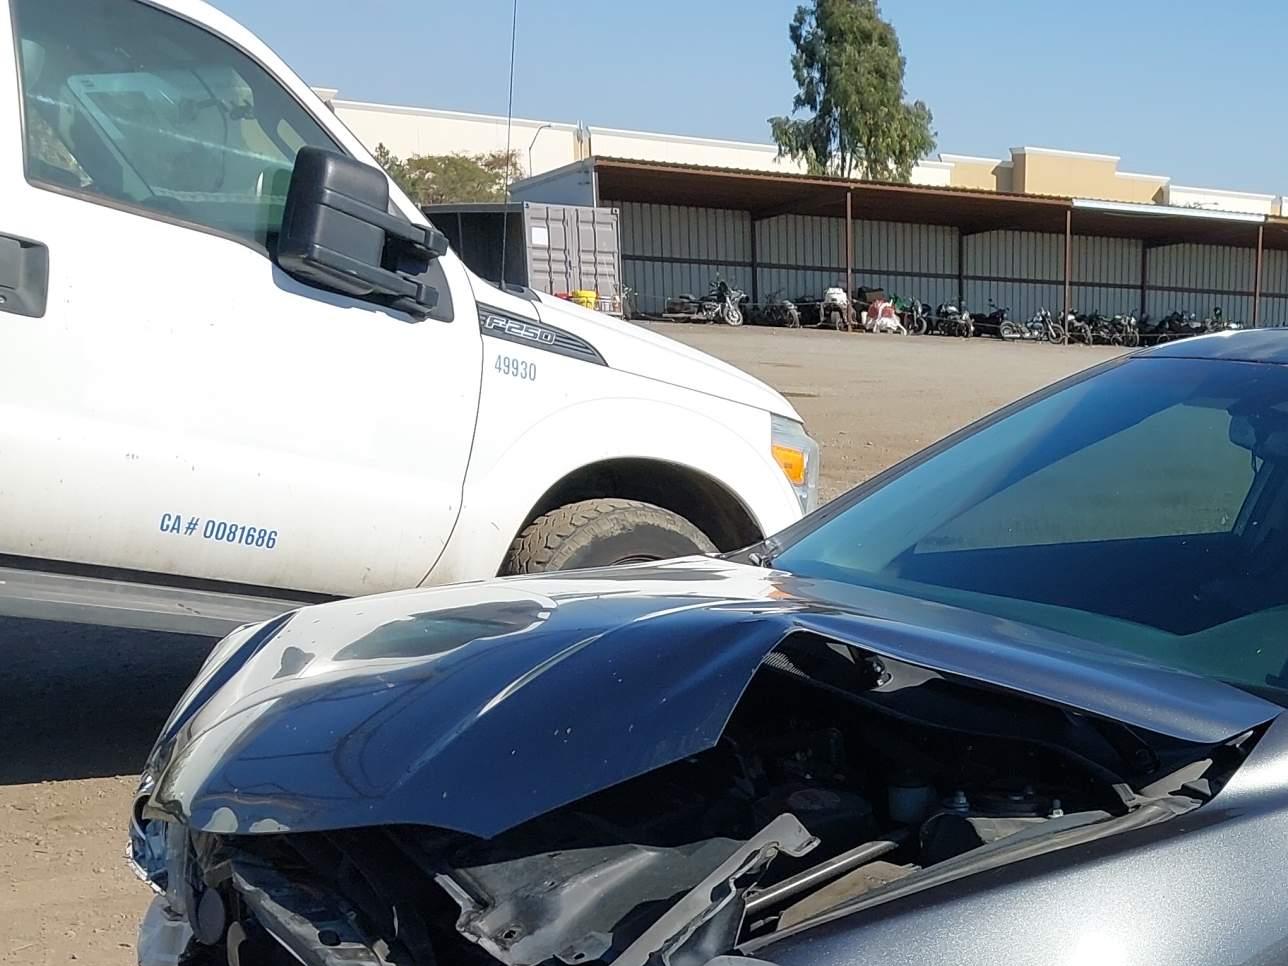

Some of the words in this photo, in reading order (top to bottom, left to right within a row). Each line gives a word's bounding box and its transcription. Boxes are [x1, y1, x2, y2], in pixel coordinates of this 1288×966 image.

[485, 315, 556, 345] F-250
[494, 354, 537, 382] 49930
[160, 513, 181, 534] CA
[184, 516, 200, 536] #
[203, 519, 278, 549] 0081686
